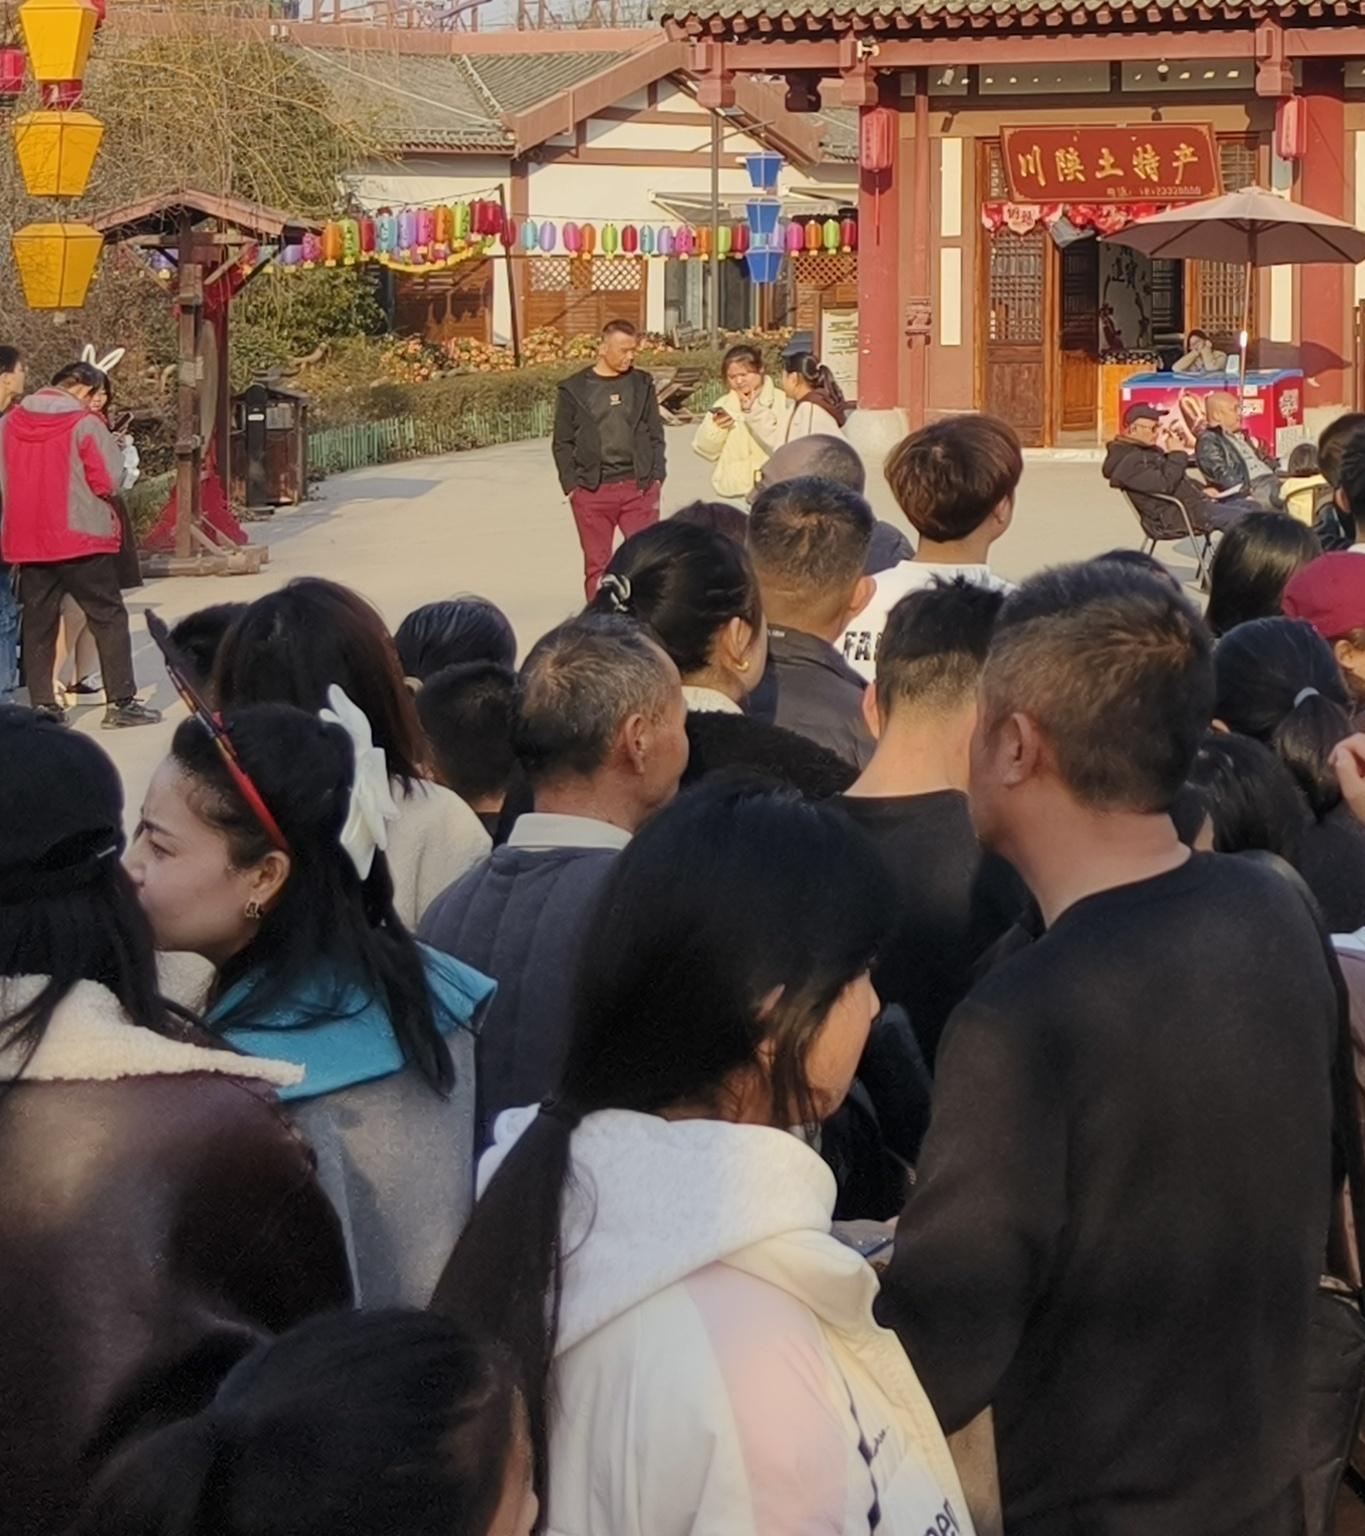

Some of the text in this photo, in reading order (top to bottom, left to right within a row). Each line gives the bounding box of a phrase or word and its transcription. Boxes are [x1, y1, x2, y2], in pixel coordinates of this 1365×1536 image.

[1018, 143, 1199, 187] 川陕土特产
